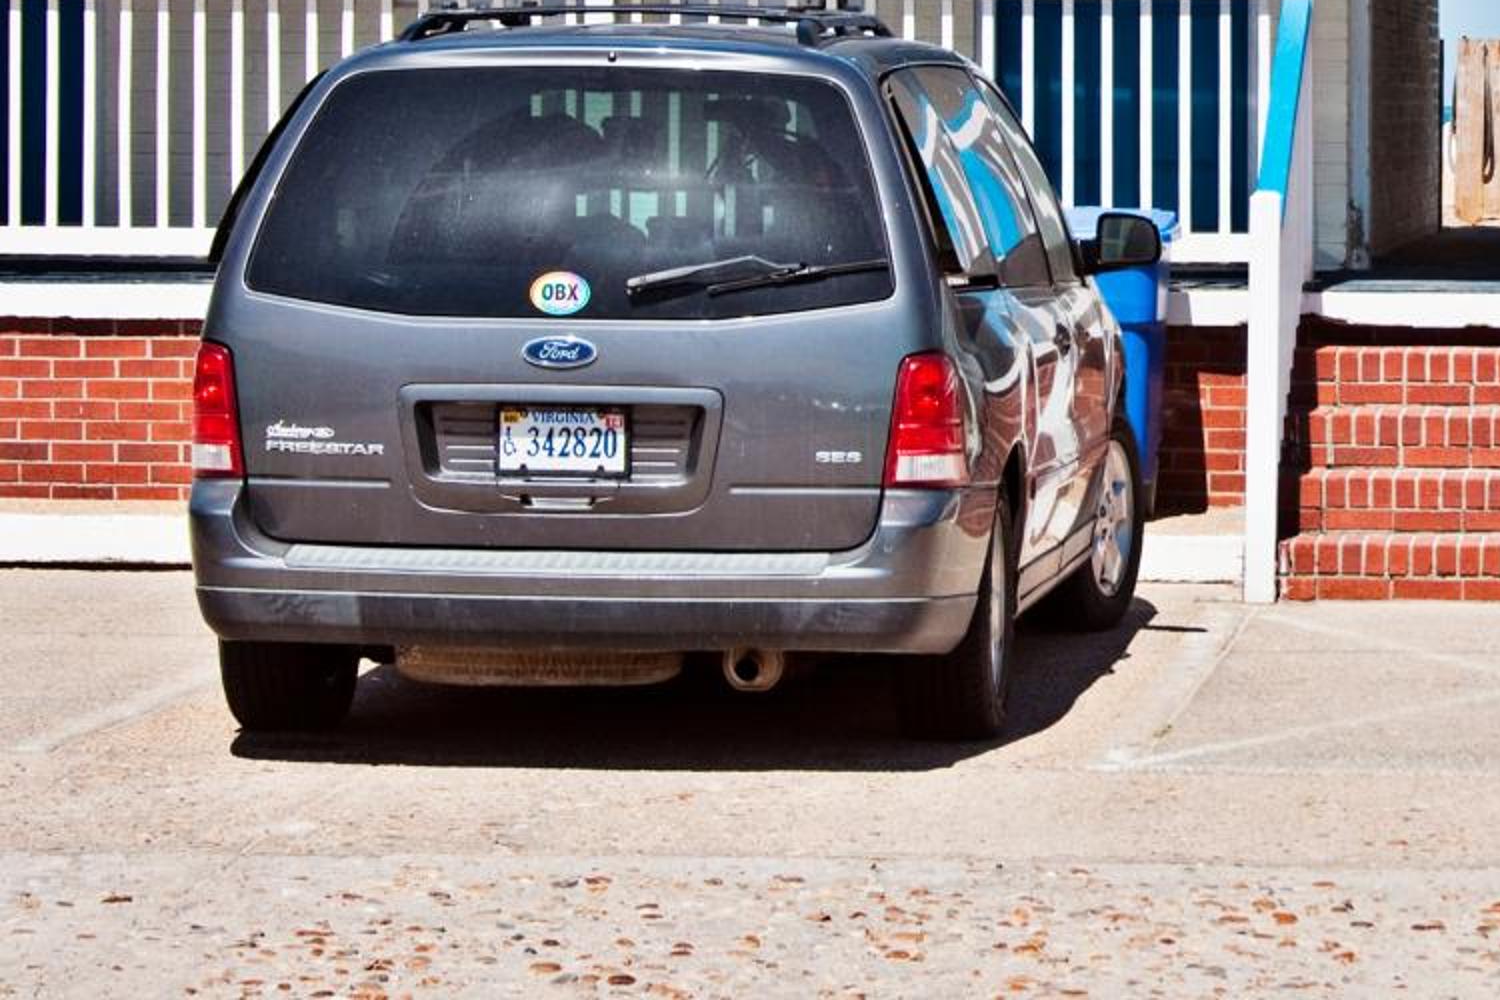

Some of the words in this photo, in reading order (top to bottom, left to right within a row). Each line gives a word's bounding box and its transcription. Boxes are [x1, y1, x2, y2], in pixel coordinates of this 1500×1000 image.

[541, 283, 579, 301] OBX
[539, 341, 581, 360] Ford
[530, 410, 596, 424] VIRGINIA
[527, 427, 617, 458] 342820
[815, 451, 863, 463] SES
